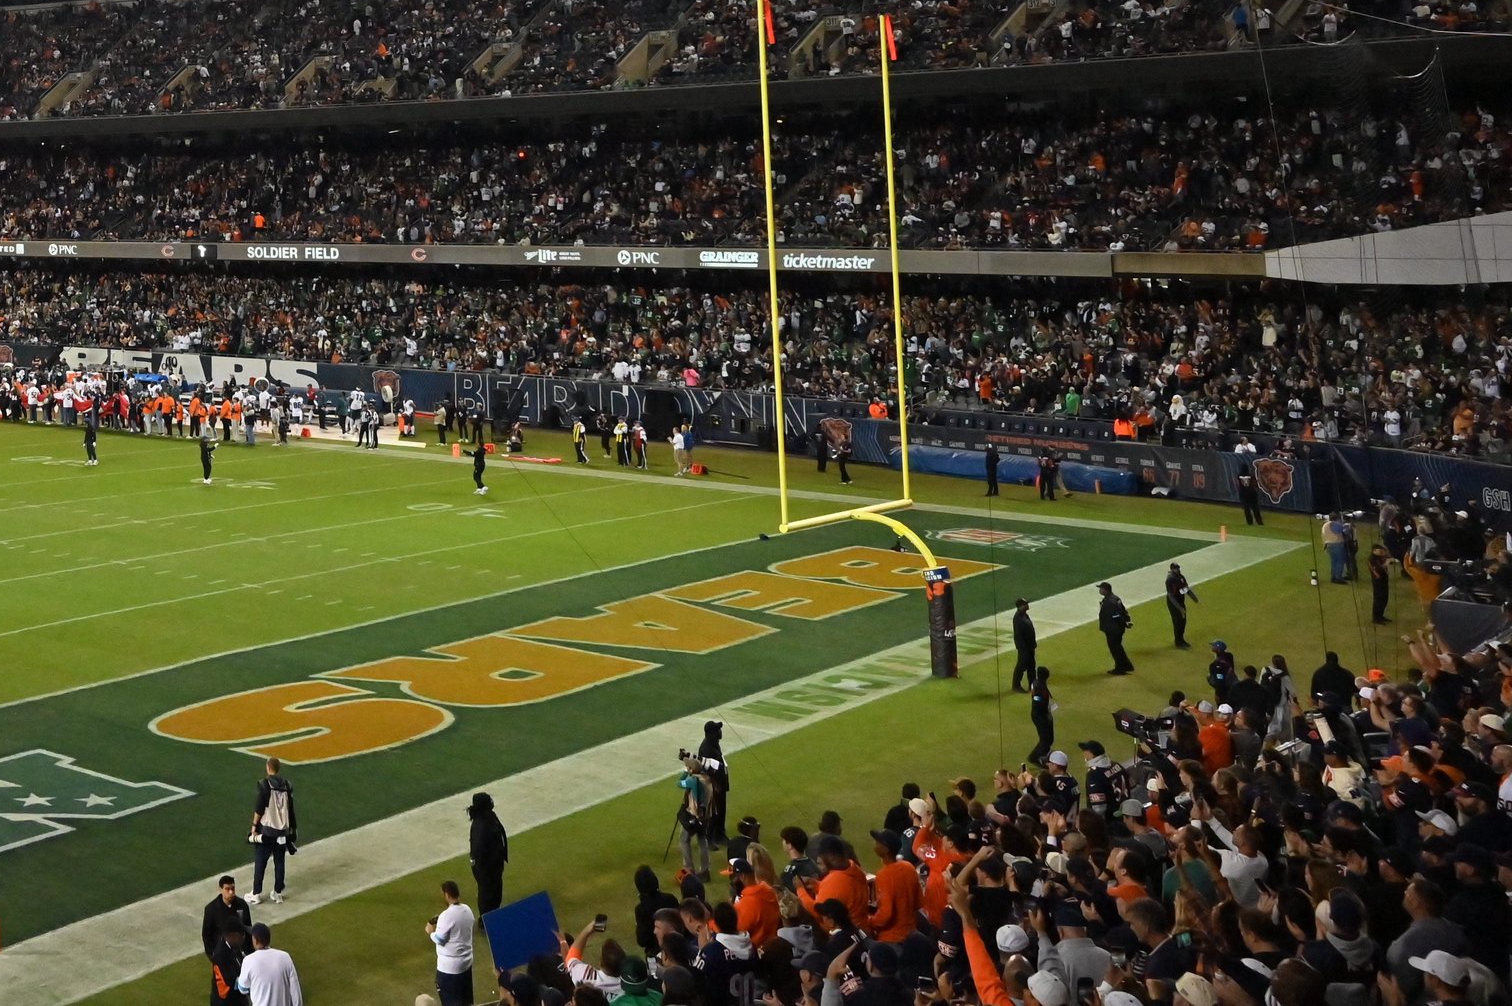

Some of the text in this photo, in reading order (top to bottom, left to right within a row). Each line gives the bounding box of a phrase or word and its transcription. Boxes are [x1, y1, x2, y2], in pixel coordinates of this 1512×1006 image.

[59, 245, 77, 255] PNC
[247, 246, 339, 260] SOLDIER FIELD
[538, 249, 557, 263] Lite
[699, 251, 759, 263] GRAINGER
[632, 252, 660, 265] PNC
[783, 253, 875, 269] ticketmaster
[1483, 487, 1511, 511] GSH
[147, 545, 1011, 767] BEARS
